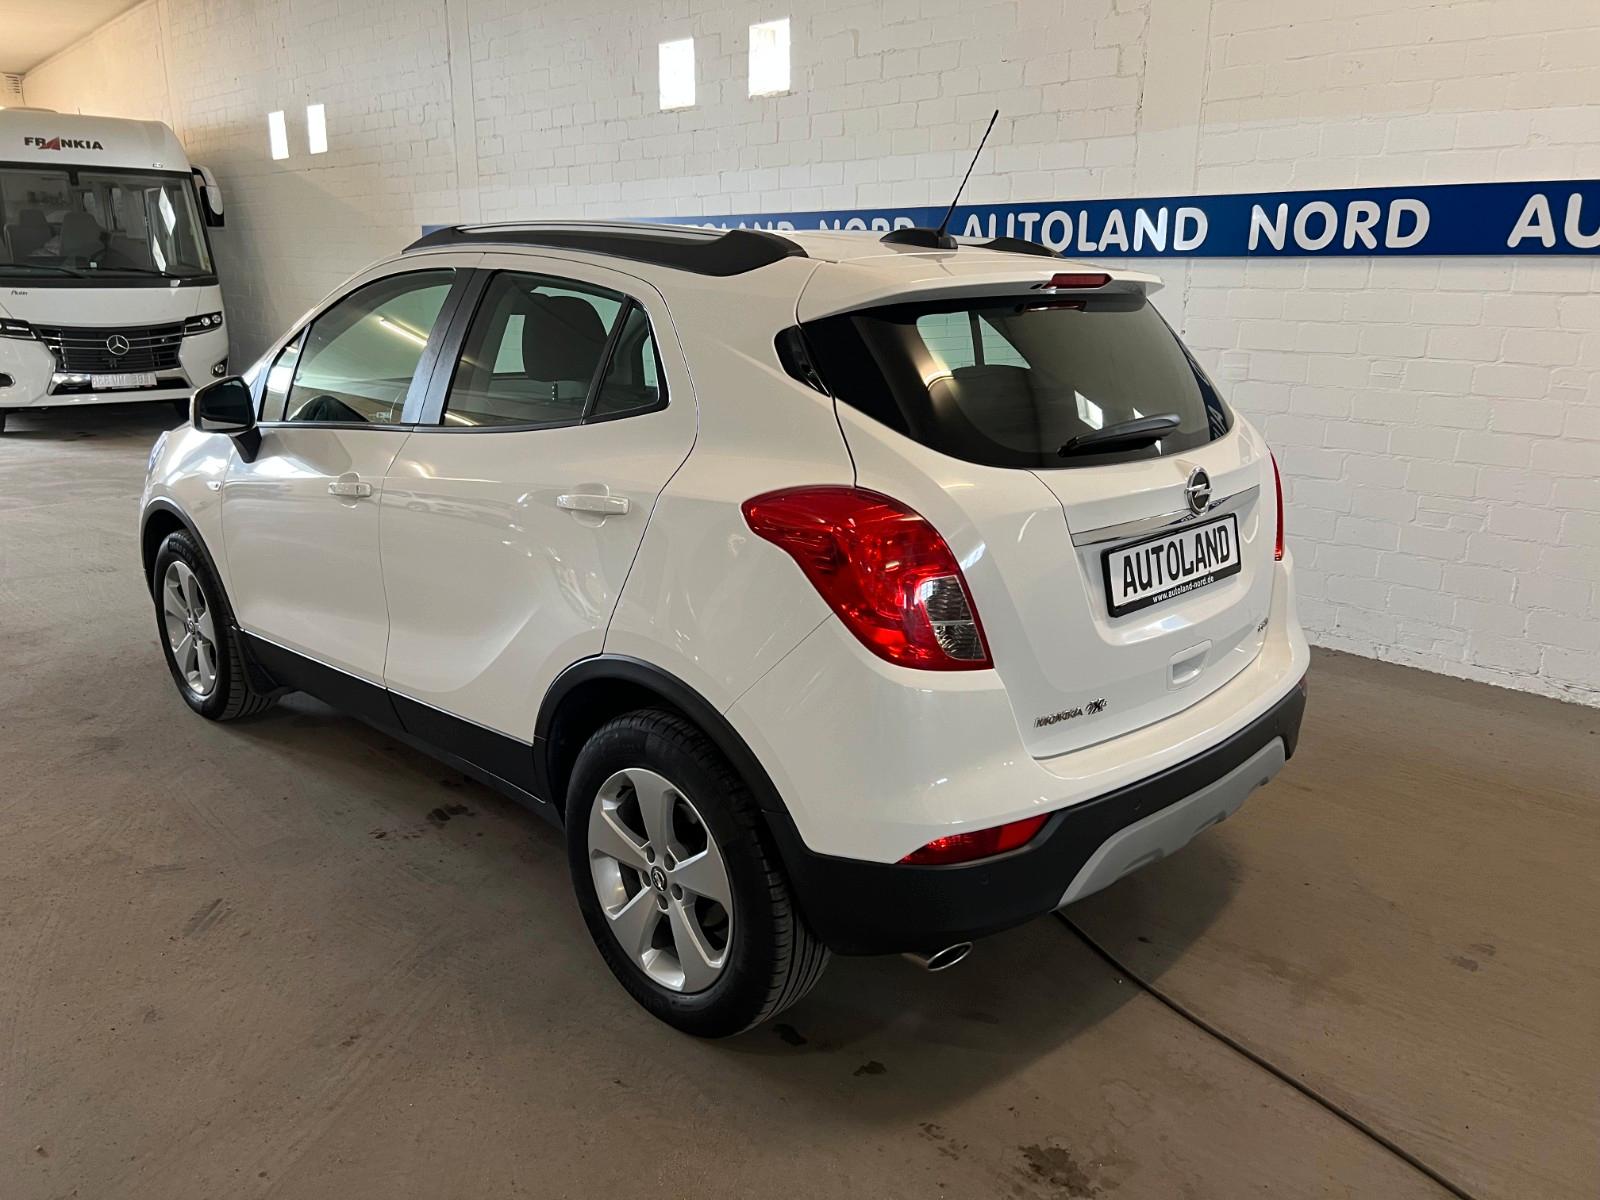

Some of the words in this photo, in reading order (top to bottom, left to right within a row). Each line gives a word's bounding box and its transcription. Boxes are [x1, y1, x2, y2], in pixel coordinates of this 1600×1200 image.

[24, 136, 103, 151] FRANKIA
[963, 207, 1208, 252] AUTOLAND
[1248, 198, 1430, 251] NORD
[1123, 524, 1231, 597] AUTOLAND
[1152, 574, 1214, 603] www.autoland-nord.de
